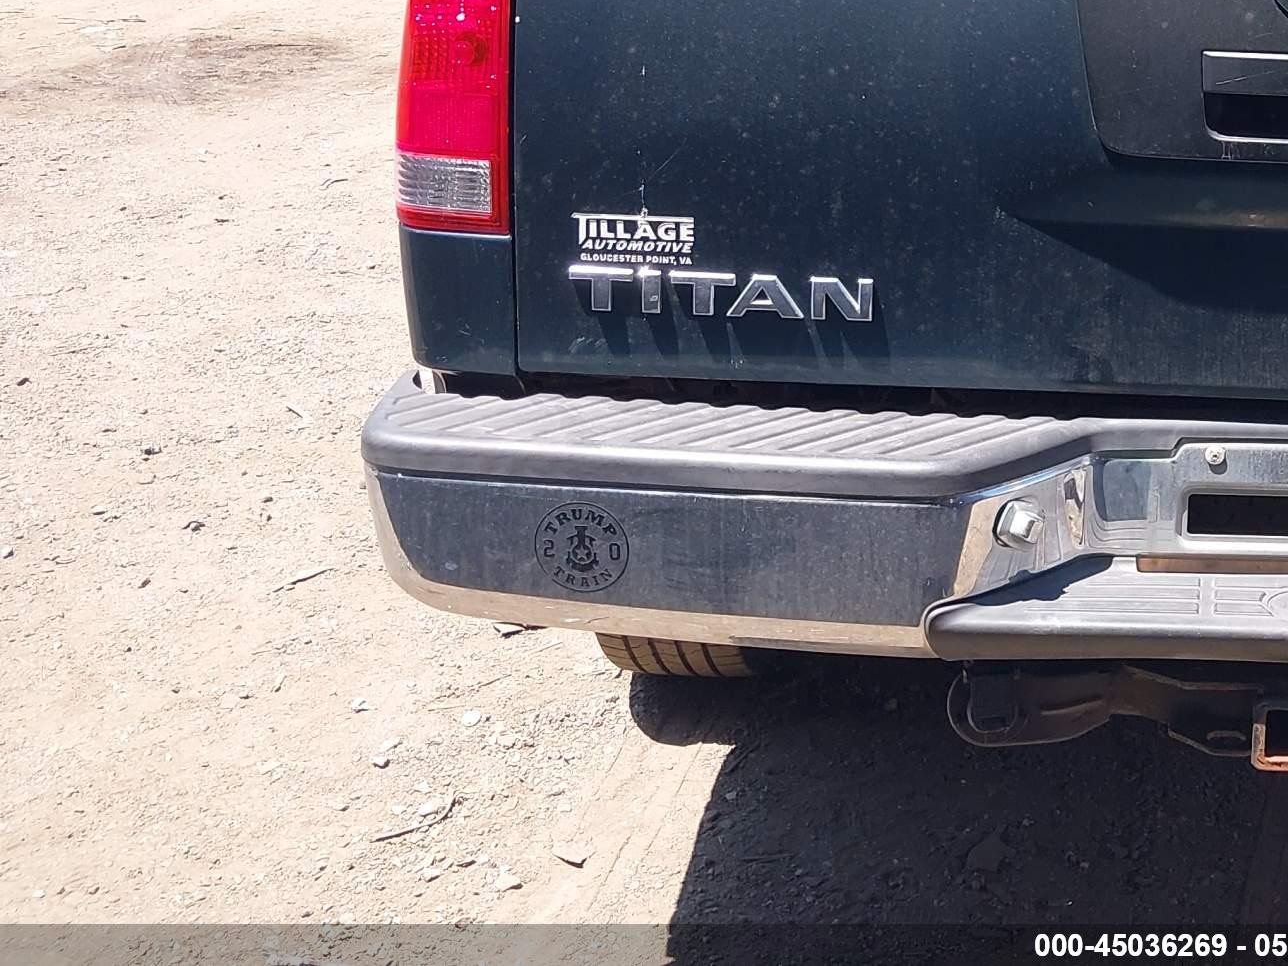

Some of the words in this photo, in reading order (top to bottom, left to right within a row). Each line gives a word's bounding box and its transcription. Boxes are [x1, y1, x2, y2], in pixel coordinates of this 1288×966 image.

[571, 212, 695, 244] TILLAGE
[582, 238, 694, 254] AUTOMOTIVE
[580, 252, 644, 264] GLOUCESTER
[645, 255, 677, 266] POINT,
[678, 256, 692, 265] VA
[568, 264, 874, 321] TITAN
[544, 508, 617, 535] TRUMP
[554, 566, 613, 587] TRAIN
